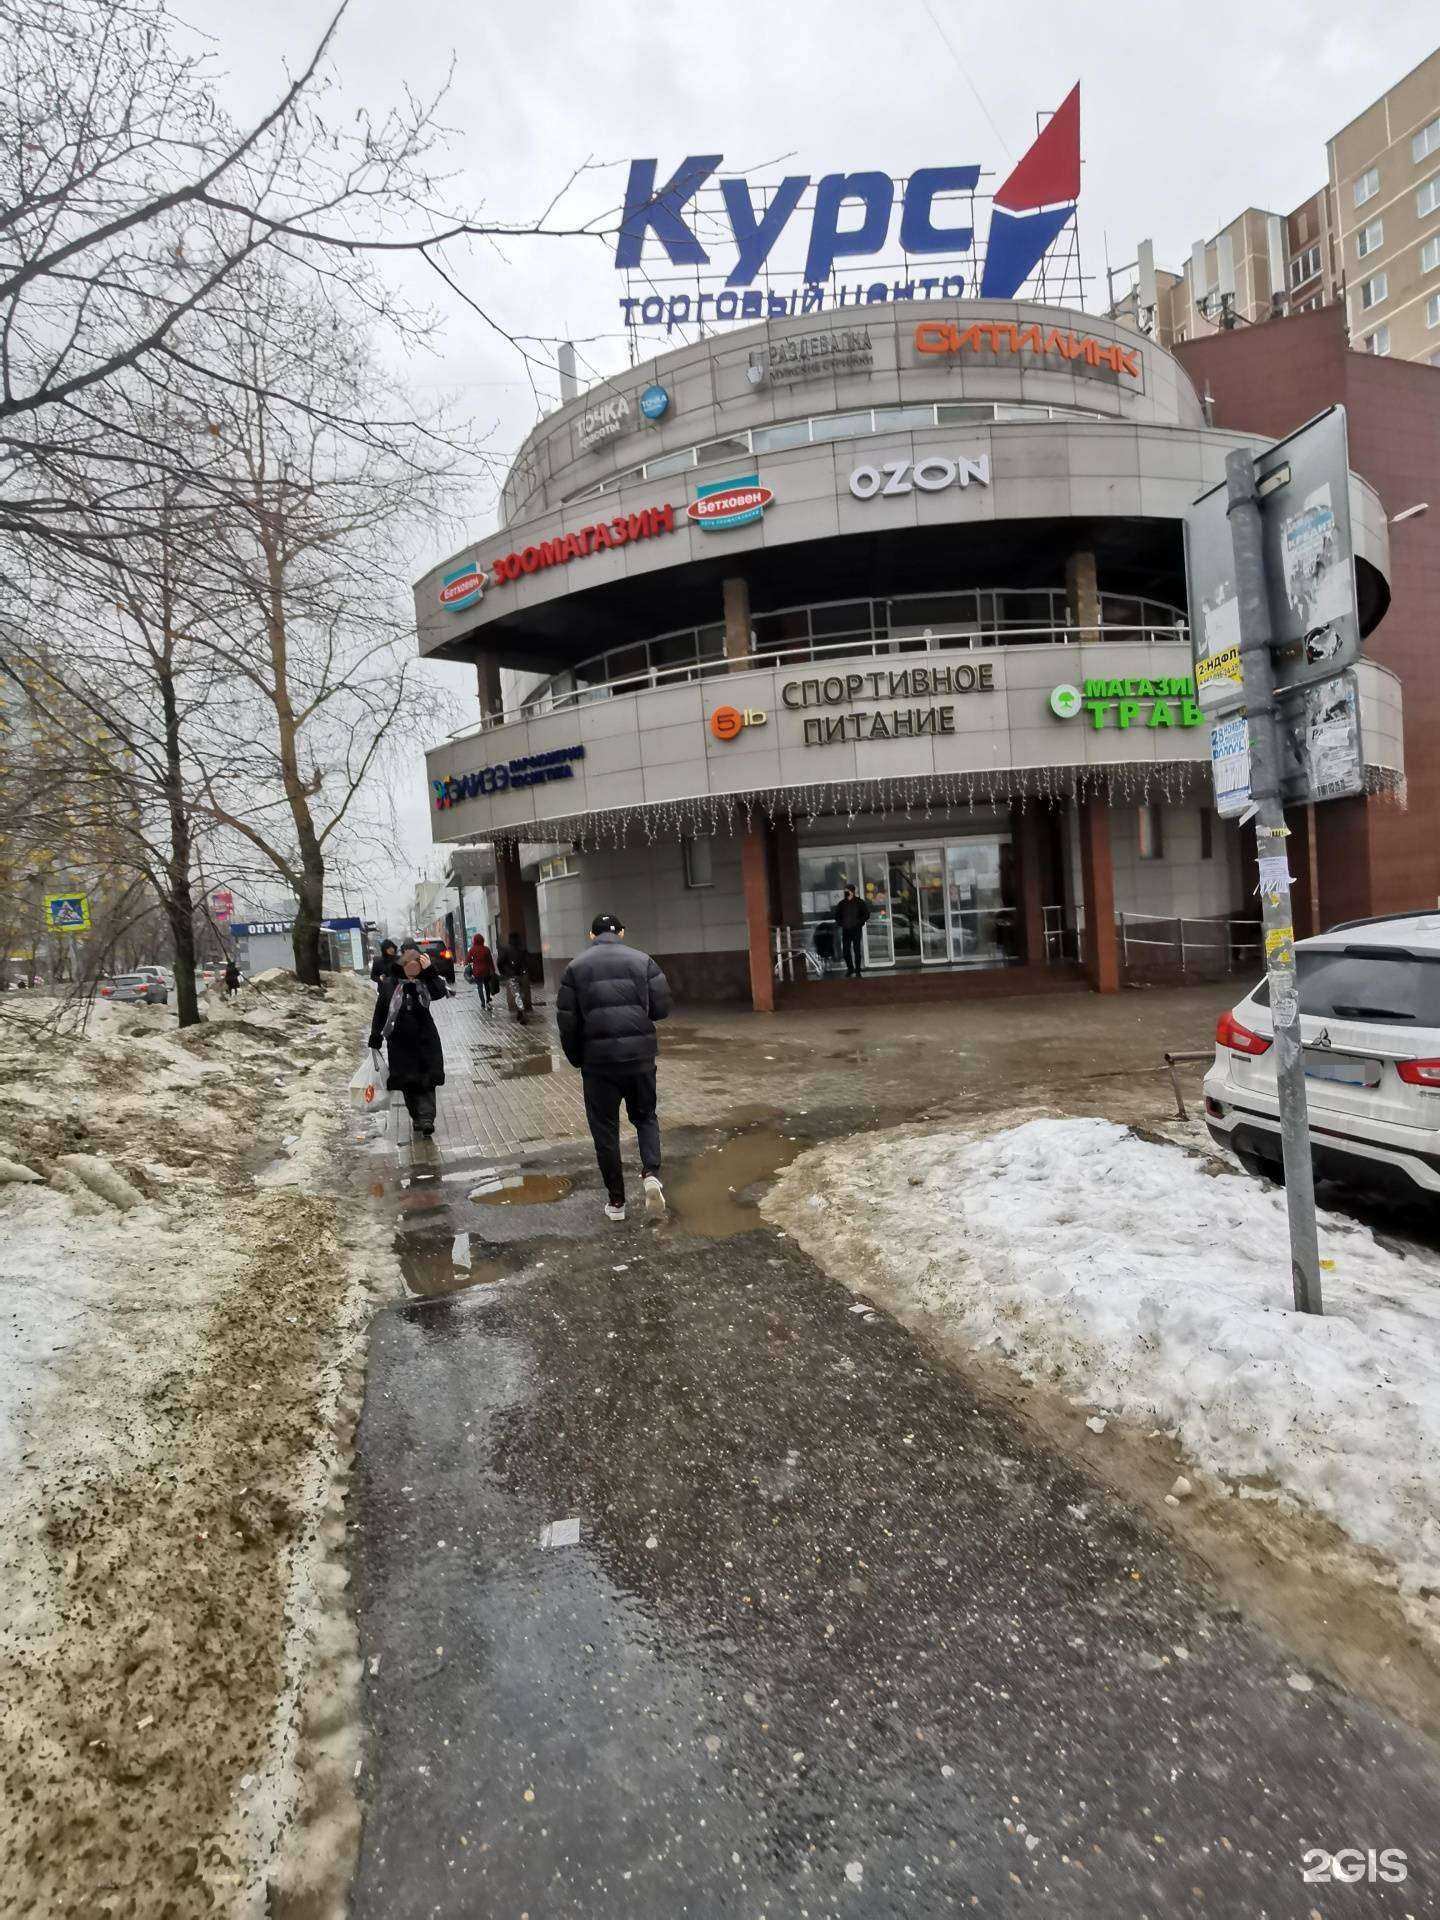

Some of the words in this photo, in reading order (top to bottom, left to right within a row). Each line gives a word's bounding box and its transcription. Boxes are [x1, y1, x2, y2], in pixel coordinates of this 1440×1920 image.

[615, 154, 980, 287] Курс
[619, 282, 826, 335] торговый
[914, 322, 1141, 378] СИТИЛИНК
[575, 397, 630, 438] ТОЧКА
[849, 453, 990, 500] OZON
[696, 491, 763, 514] Бетховен
[492, 503, 675, 587] ЗООМАГАЗИН
[781, 663, 995, 709] СПОРТИВНОЕ
[803, 706, 956, 747] ПИТАНИЕ
